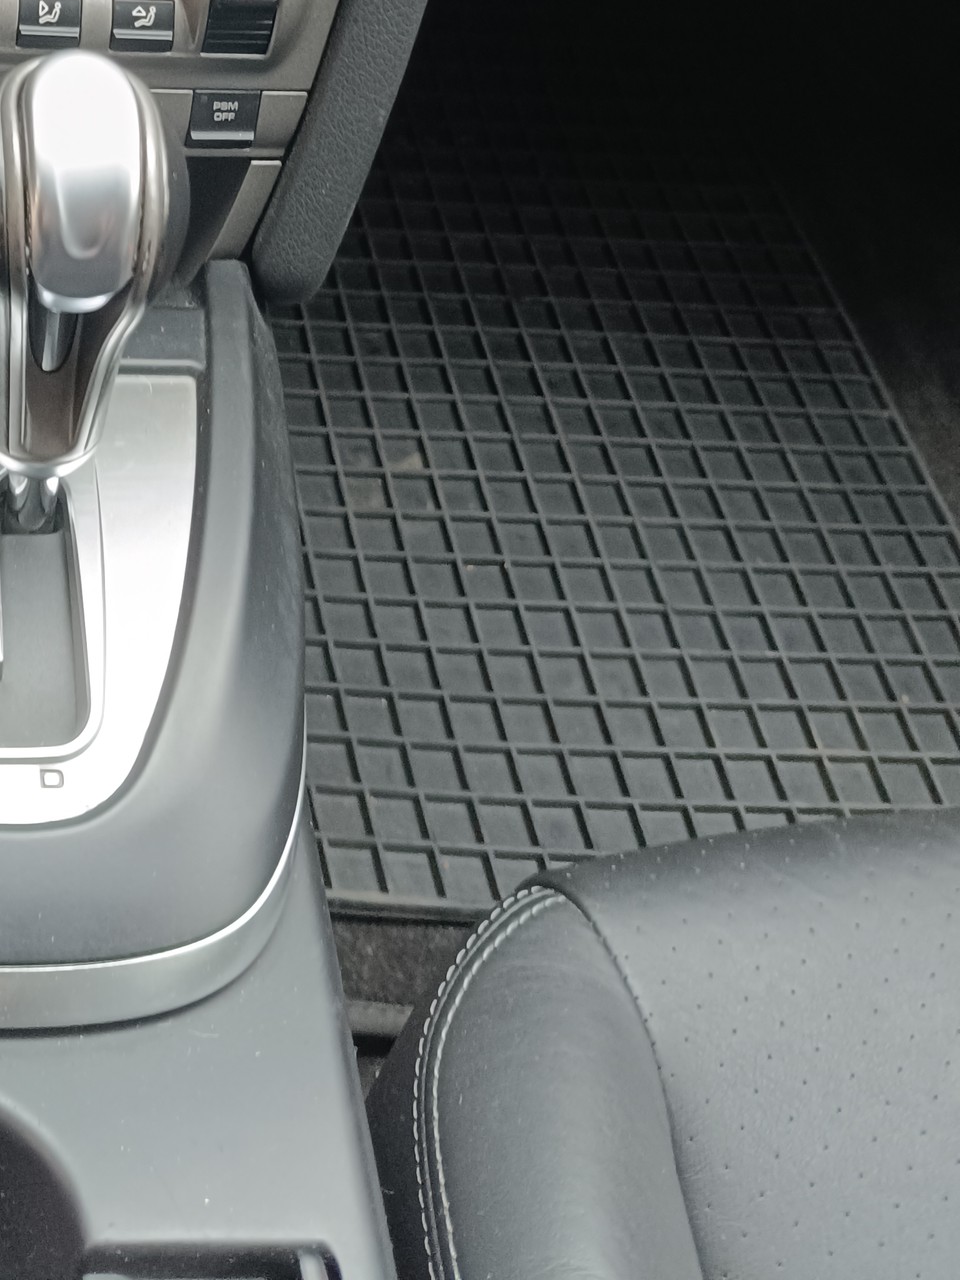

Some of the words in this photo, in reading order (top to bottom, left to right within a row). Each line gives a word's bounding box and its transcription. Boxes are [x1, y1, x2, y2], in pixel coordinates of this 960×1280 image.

[213, 101, 238, 112] PSM
[213, 111, 236, 121] OFF
[39, 768, 65, 789] D
